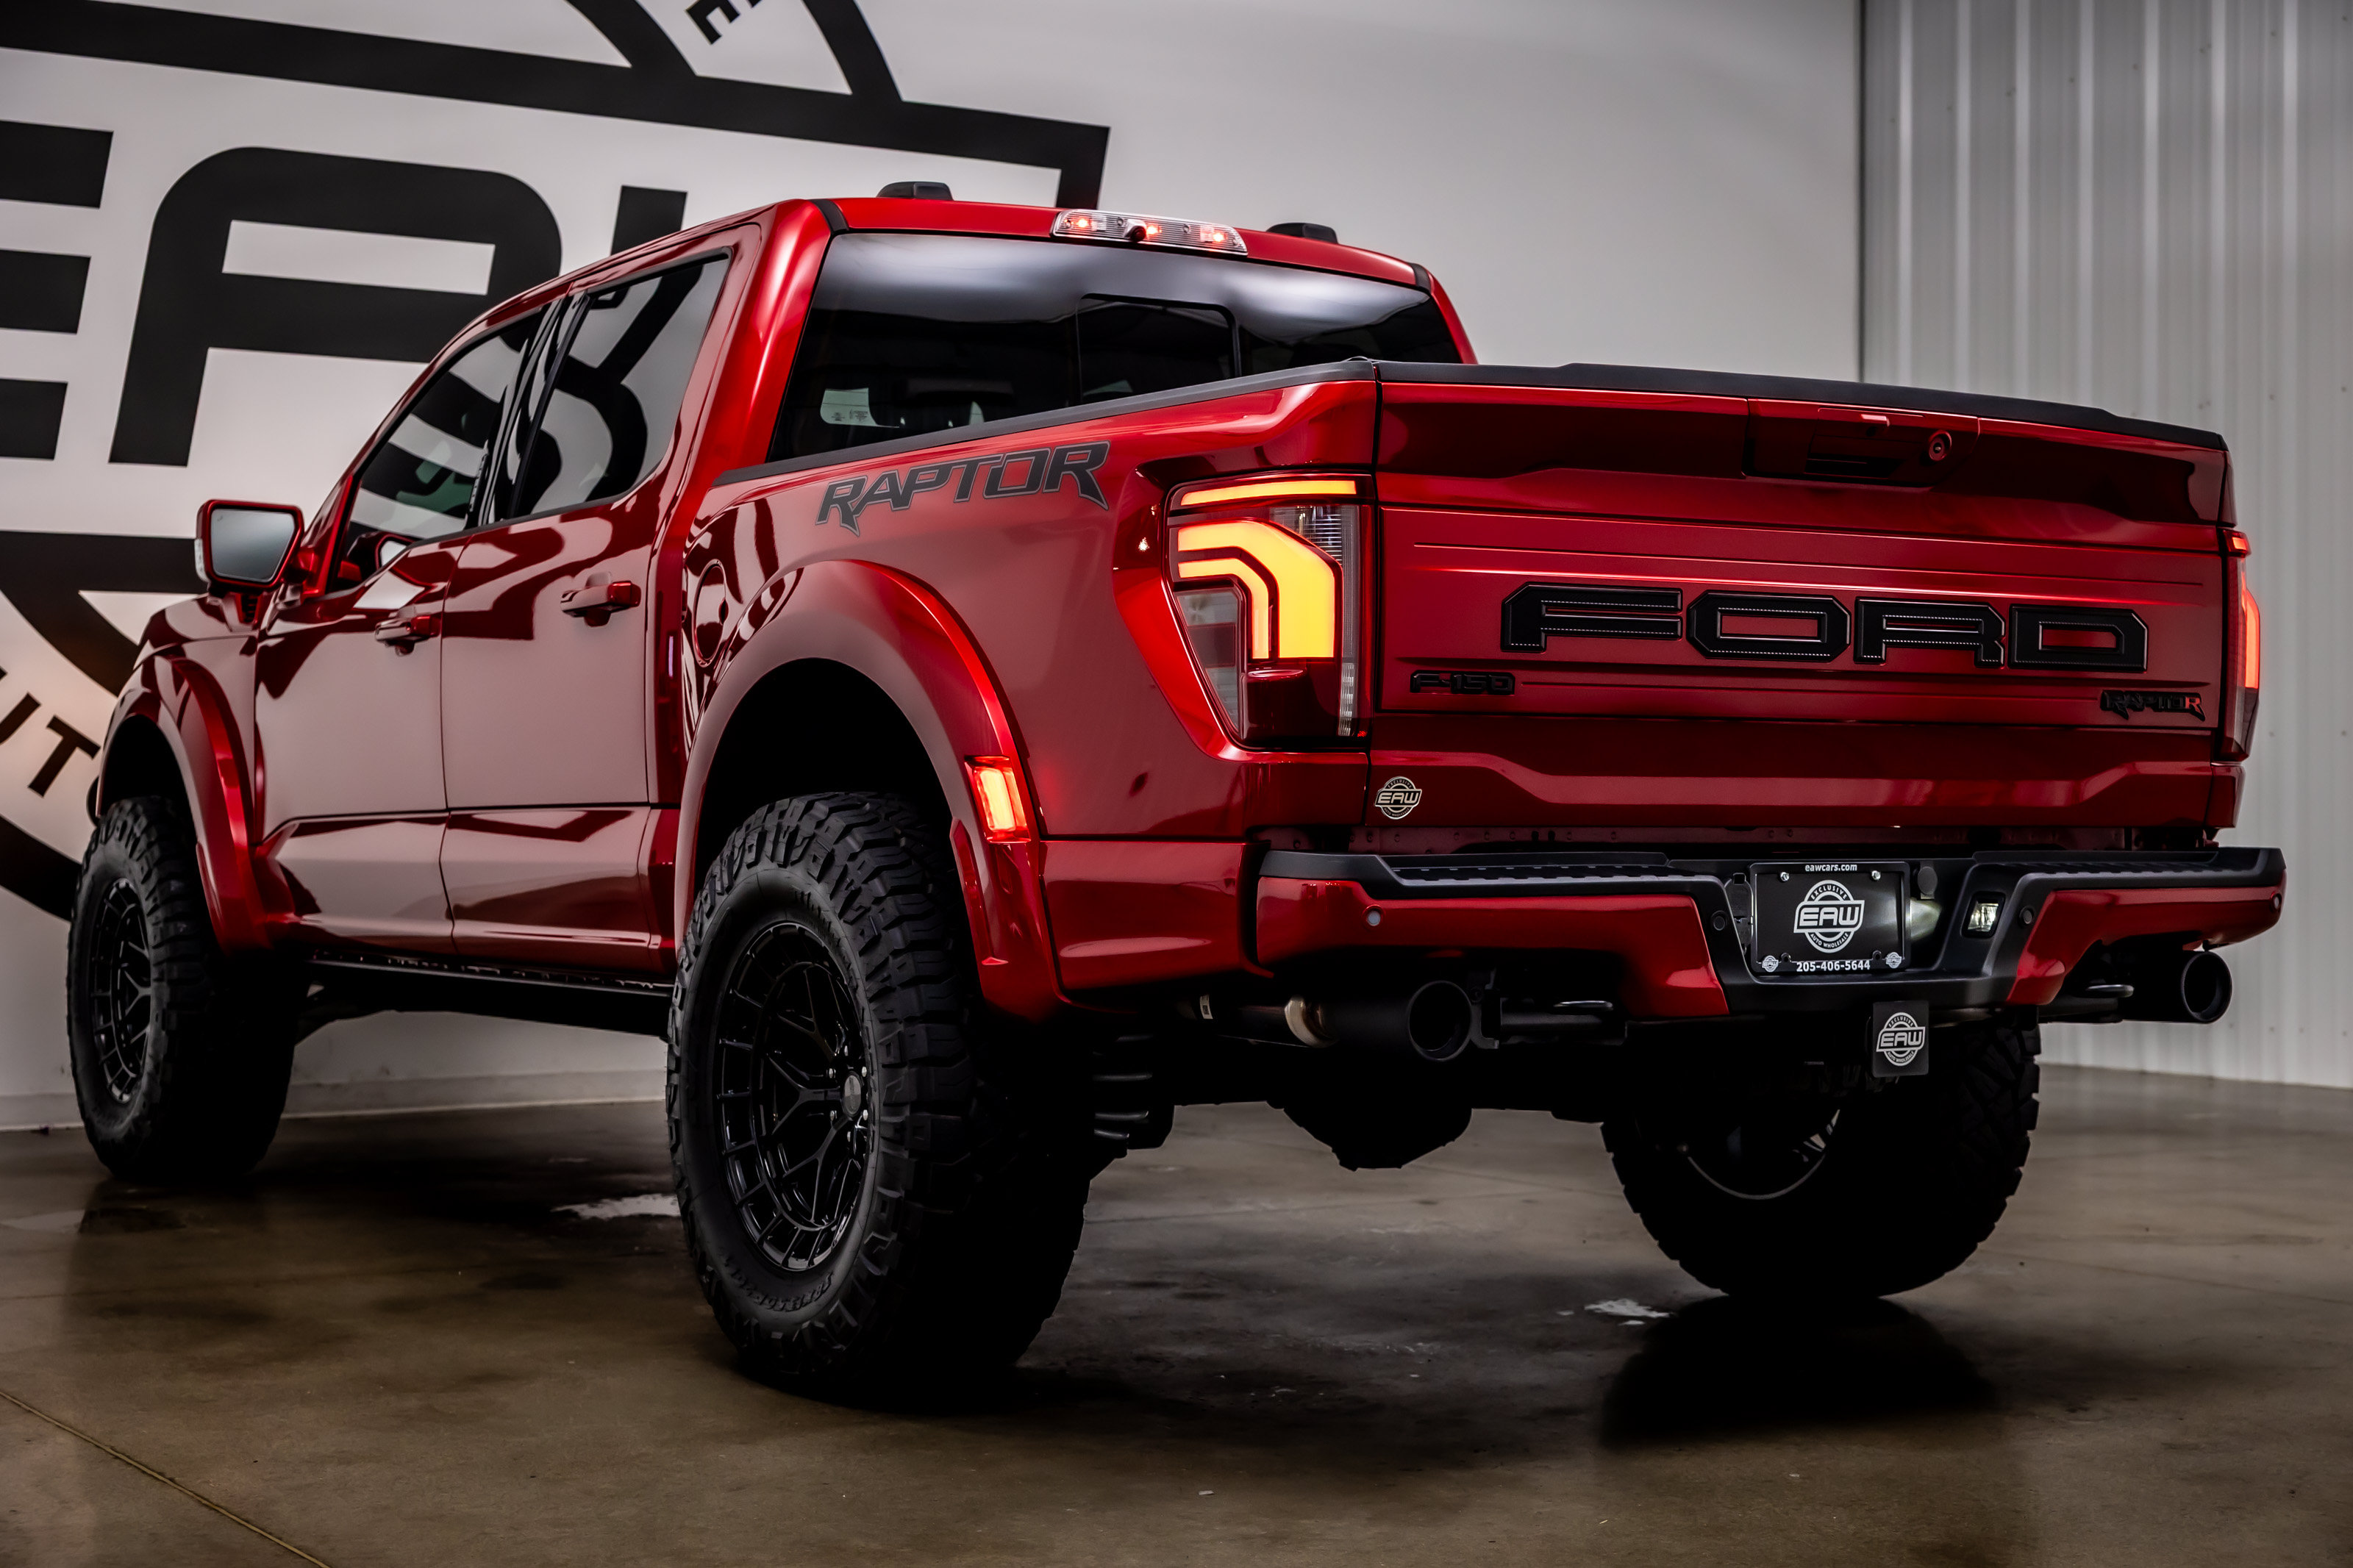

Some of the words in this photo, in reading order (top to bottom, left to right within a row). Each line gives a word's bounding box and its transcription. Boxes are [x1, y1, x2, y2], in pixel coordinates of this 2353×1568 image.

[815, 440, 1110, 537] RAPTOR
[1501, 581, 2149, 673] FORD
[1410, 670, 1515, 695] F-150
[2100, 689, 2206, 722] RAPTOR
[1377, 792, 1419, 803] EAW
[1804, 862, 1857, 873] eawcars.com
[1810, 884, 1848, 900] EXCLUSIVE
[1799, 906, 1859, 926] EAW
[1810, 933, 1822, 946] AUTO
[1796, 960, 1871, 973] 205-406-5644
[1880, 1031, 1922, 1047] EAW
